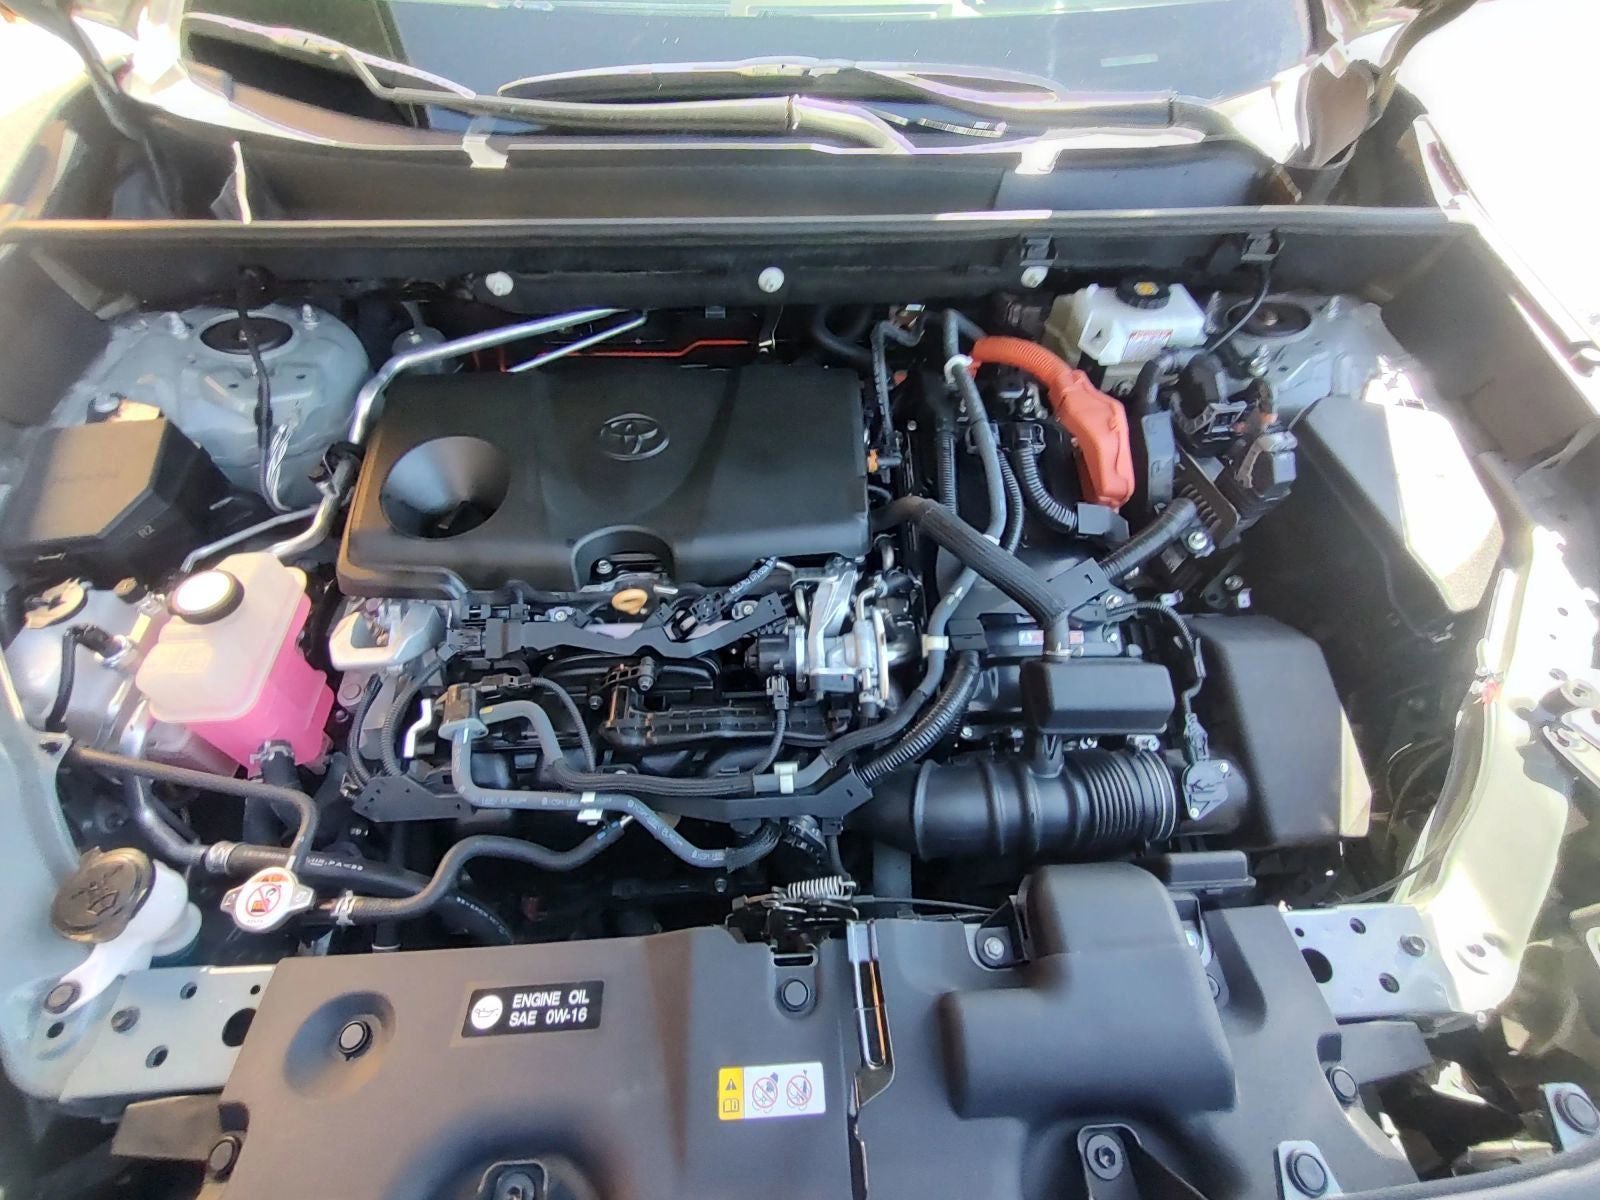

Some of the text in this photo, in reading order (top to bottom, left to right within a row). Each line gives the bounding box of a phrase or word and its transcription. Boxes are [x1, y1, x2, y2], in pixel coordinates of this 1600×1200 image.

[512, 989, 590, 1008] ENGINE OIL
[509, 1007, 588, 1027] SAE 0W-16
